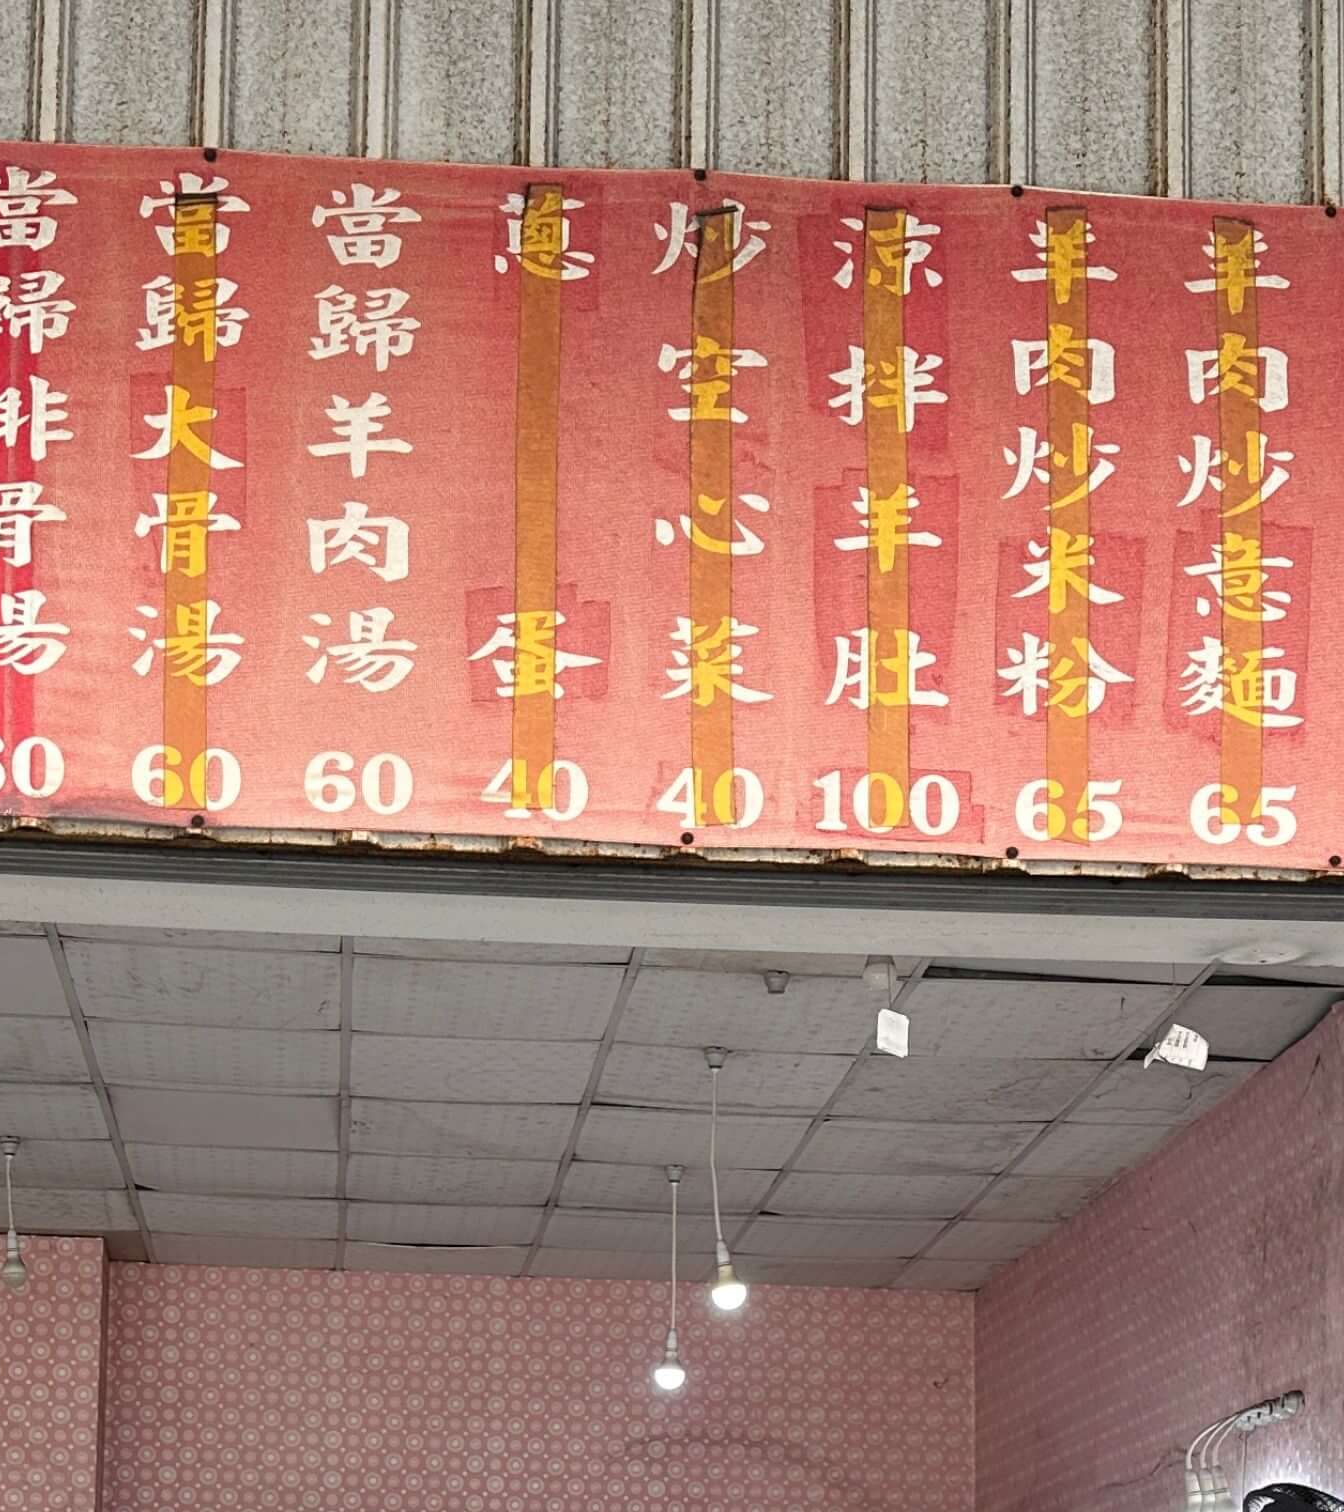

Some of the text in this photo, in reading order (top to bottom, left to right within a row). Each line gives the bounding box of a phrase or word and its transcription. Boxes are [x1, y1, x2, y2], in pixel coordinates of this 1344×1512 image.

[130, 171, 251, 813] 當歸大骨湯 60
[303, 183, 422, 815] 當歸羊肉湯 60
[480, 759, 589, 822] 40
[651, 200, 774, 830] 炒空心菜 40
[813, 210, 960, 833] 涼拌羊肚 100
[996, 218, 1136, 844] 羊肉炒米粉 65
[1176, 226, 1305, 847] 羊肉炒意麵 65
